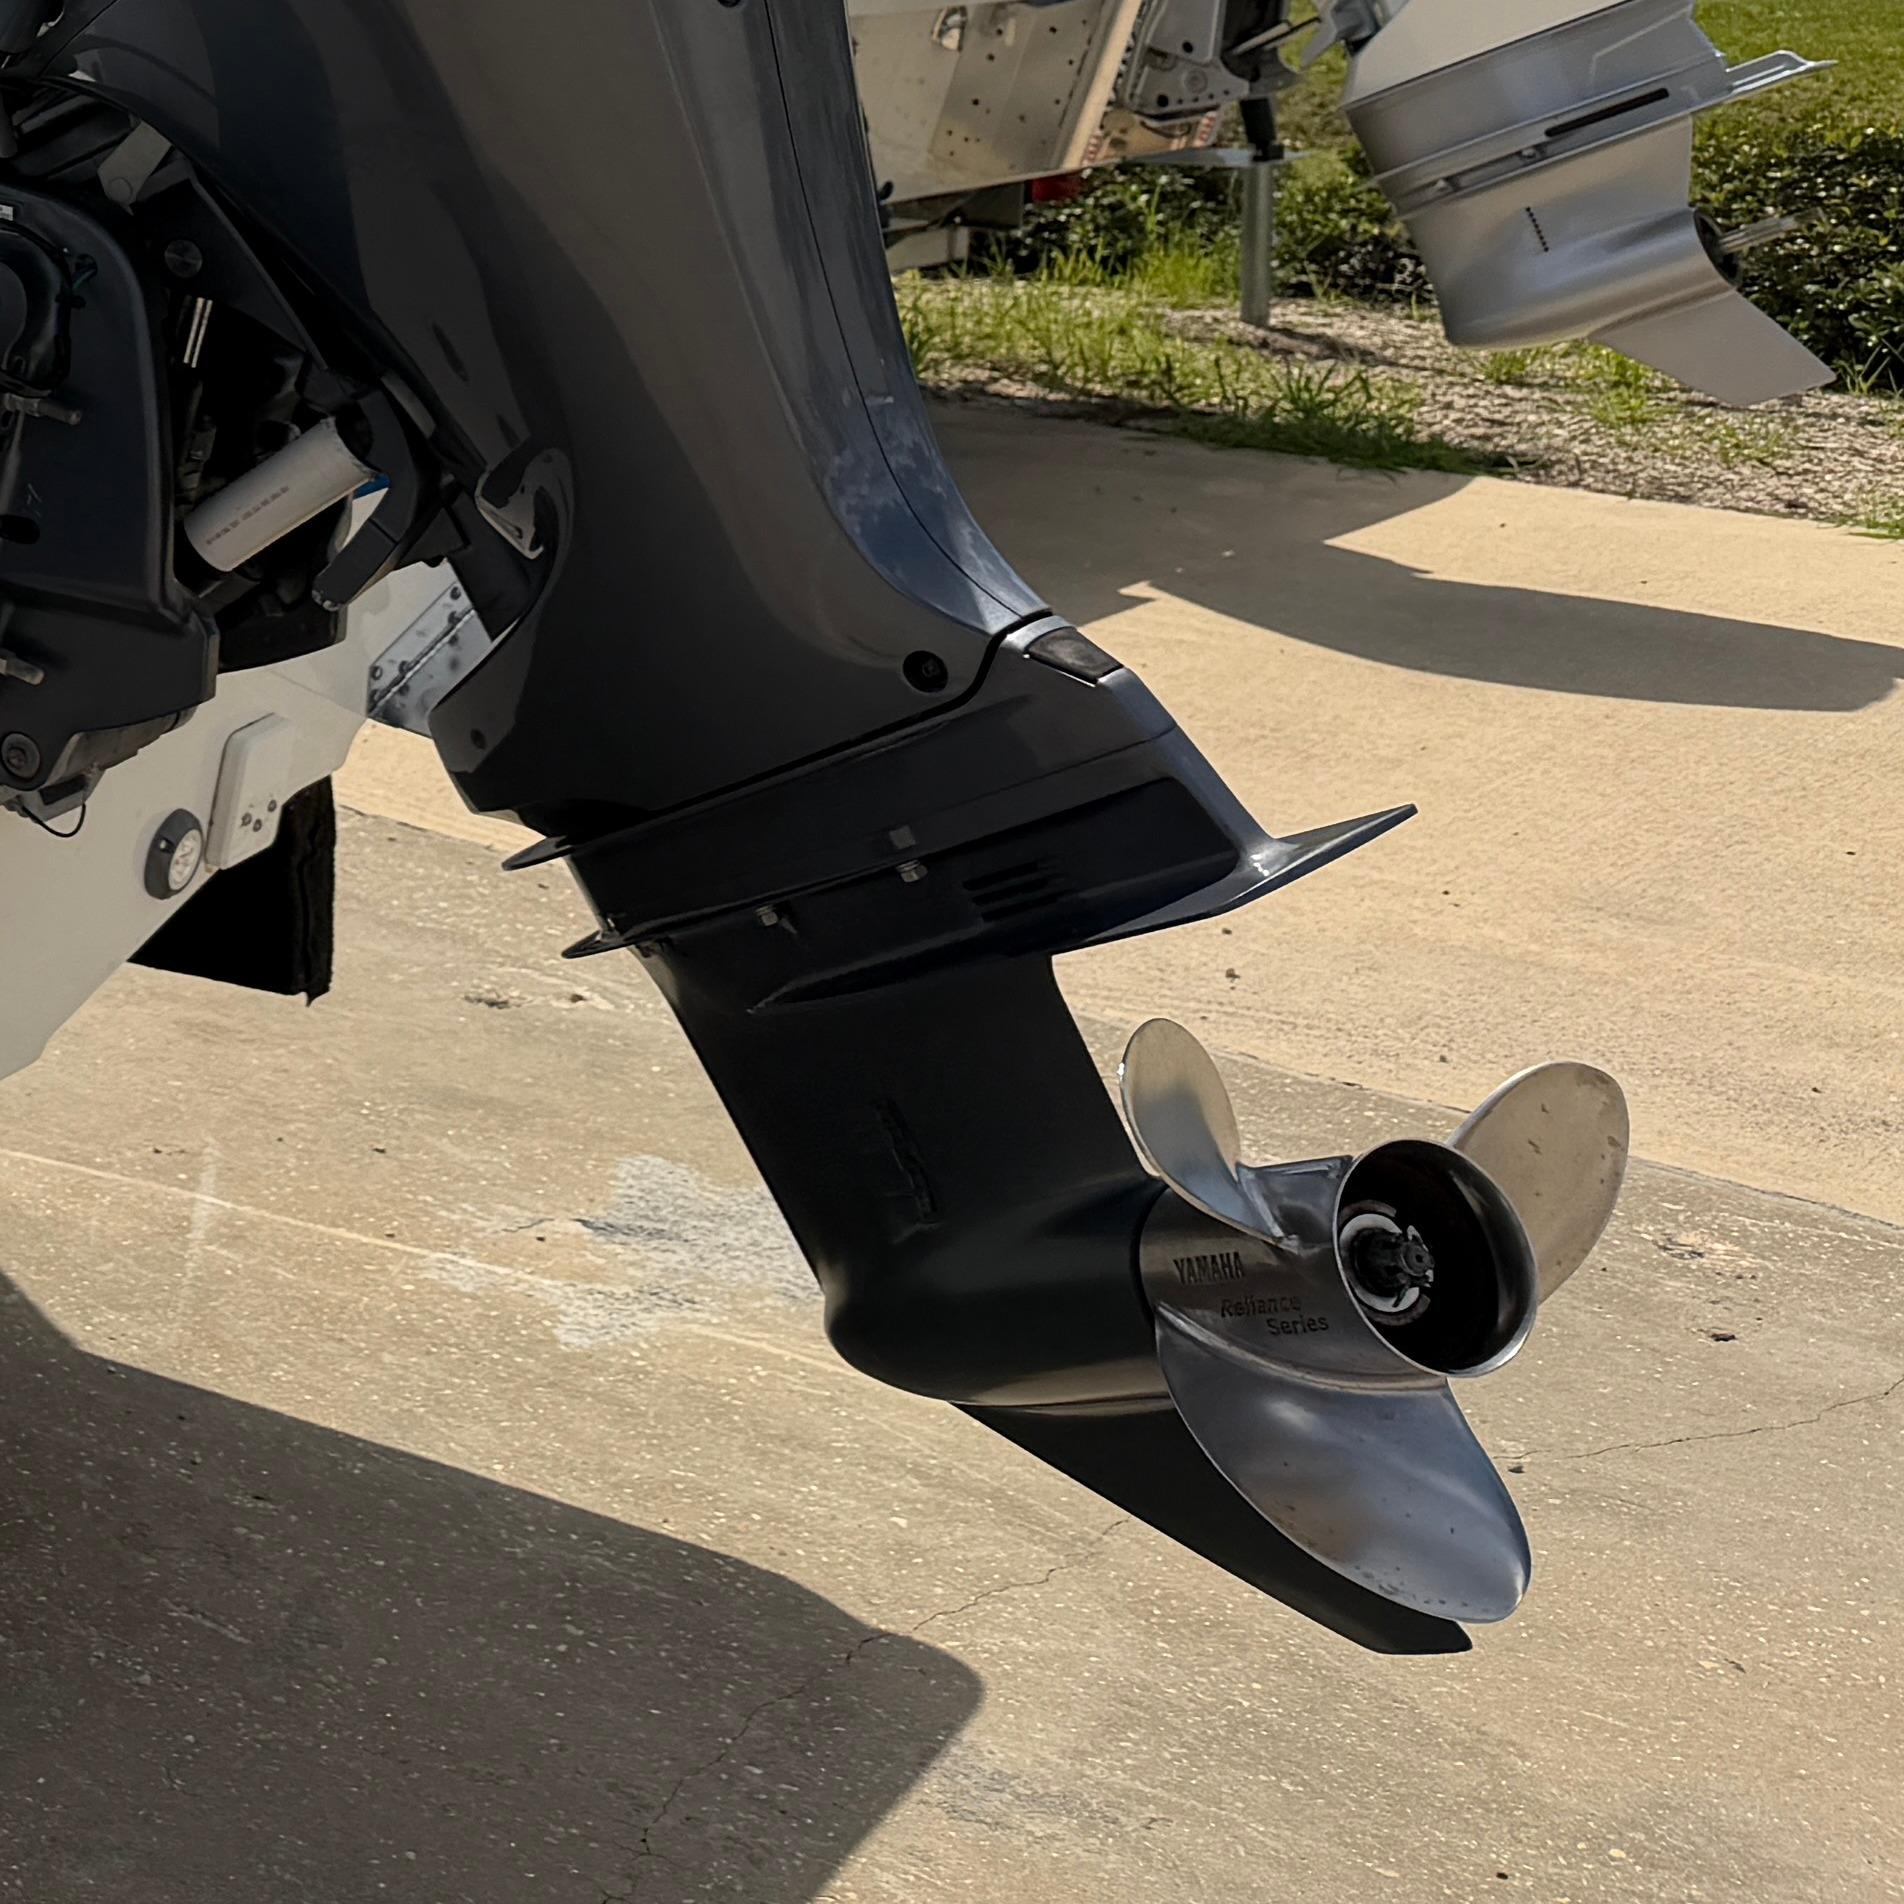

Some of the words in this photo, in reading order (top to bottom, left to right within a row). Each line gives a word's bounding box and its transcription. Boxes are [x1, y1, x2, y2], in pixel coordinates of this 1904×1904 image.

[1173, 1251, 1245, 1285] YAMAHA
[1221, 1294, 1302, 1318] Reliance
[1266, 1315, 1329, 1336] Series
